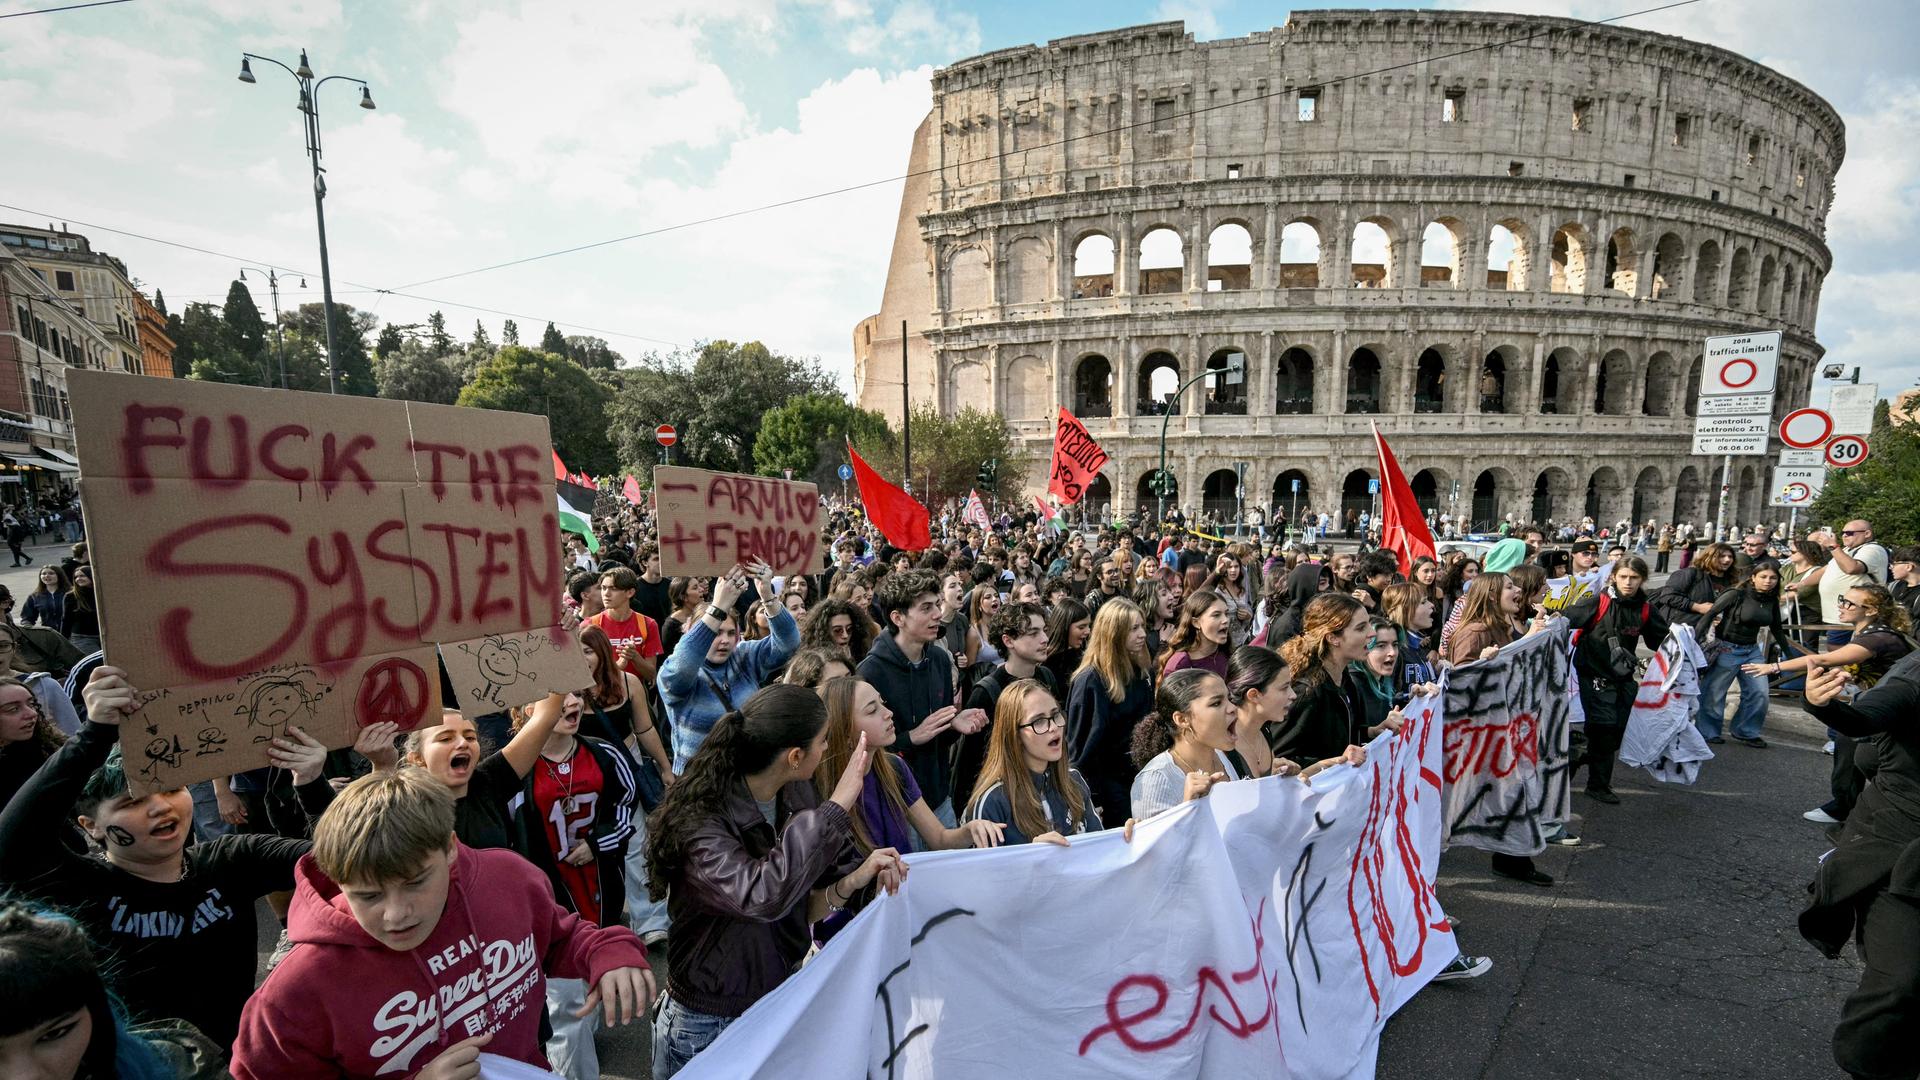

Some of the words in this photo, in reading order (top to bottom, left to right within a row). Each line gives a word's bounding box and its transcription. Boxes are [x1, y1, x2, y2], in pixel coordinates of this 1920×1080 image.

[1710, 347, 1739, 356] traffico
[1742, 345, 1774, 353] limitato
[121, 402, 376, 500] FUCK
[406, 440, 545, 517] THE
[1833, 444, 1858, 459] 30
[706, 475, 793, 523] ARMI
[706, 522, 816, 575] FEMBOY
[177, 692, 236, 717] PEPPINO
[548, 791, 600, 861] 12
[428, 933, 486, 976] REAL
